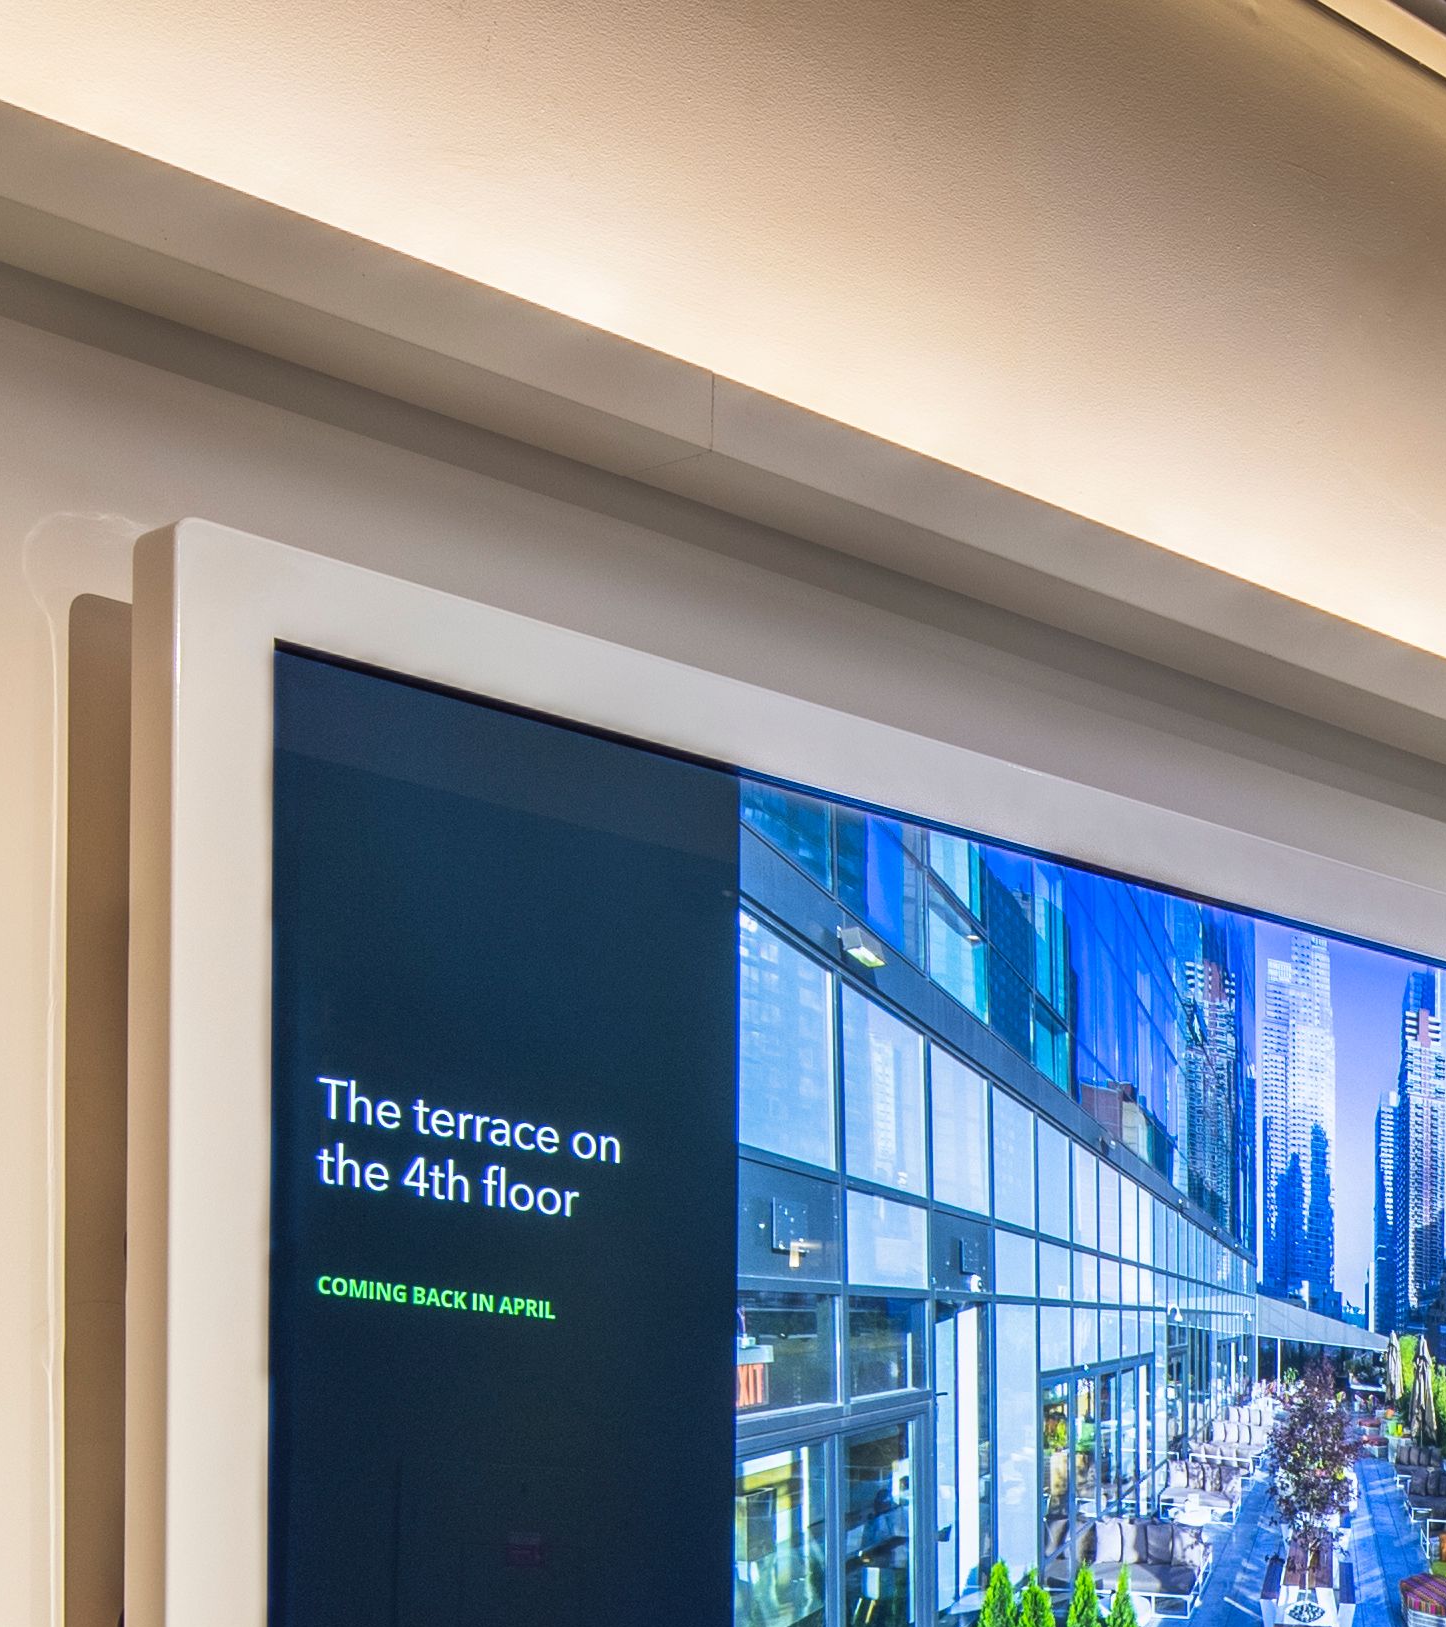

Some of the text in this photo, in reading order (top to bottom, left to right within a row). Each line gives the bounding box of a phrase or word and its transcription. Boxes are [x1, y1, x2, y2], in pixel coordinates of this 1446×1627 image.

[317, 1076, 622, 1164] The terrace on
[317, 1143, 579, 1217] the 4th floor
[317, 1275, 556, 1320] COMING BACK IN APRIL
